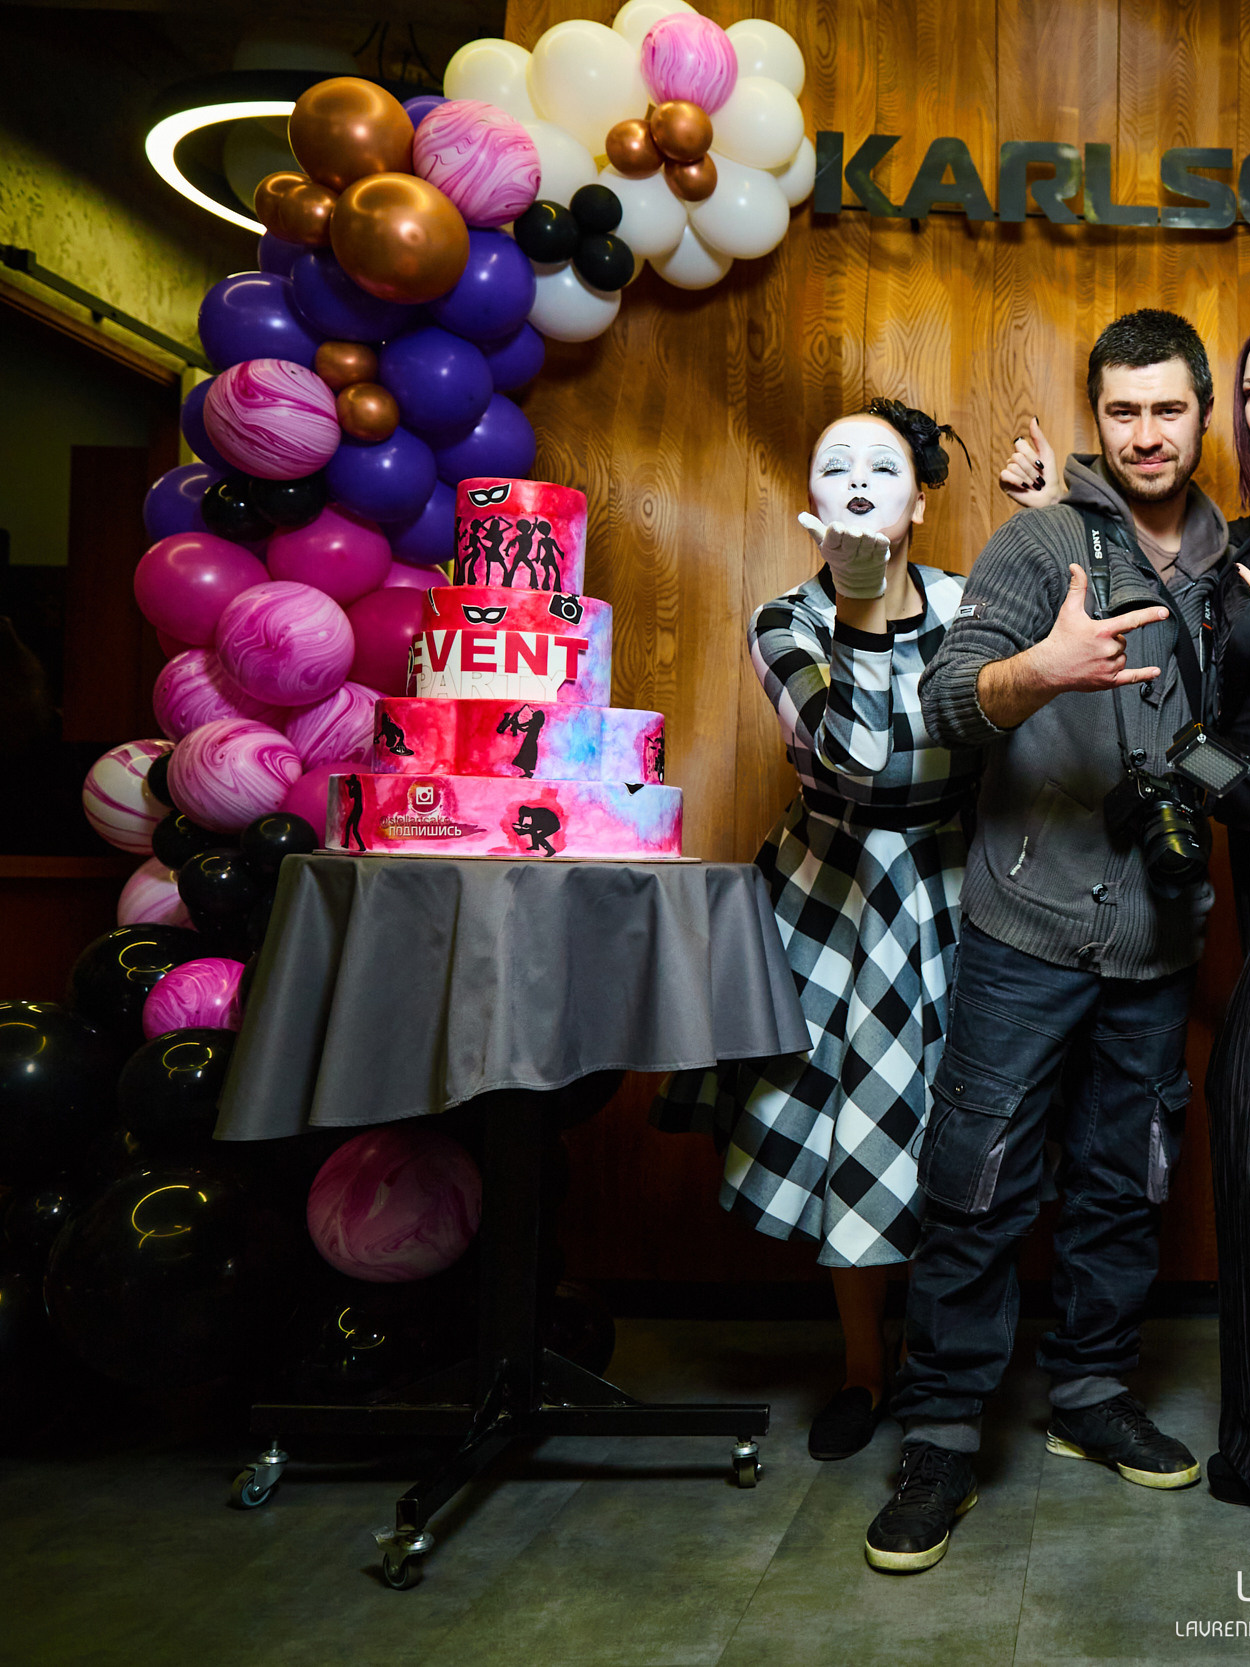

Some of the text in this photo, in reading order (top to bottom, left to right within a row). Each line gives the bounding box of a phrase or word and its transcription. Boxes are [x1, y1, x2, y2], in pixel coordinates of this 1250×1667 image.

[1092, 529, 1103, 559] SONY
[411, 629, 589, 680] EVENT
[419, 664, 567, 702] PARTY
[388, 825, 462, 837] ПОДПИШИСЬ
